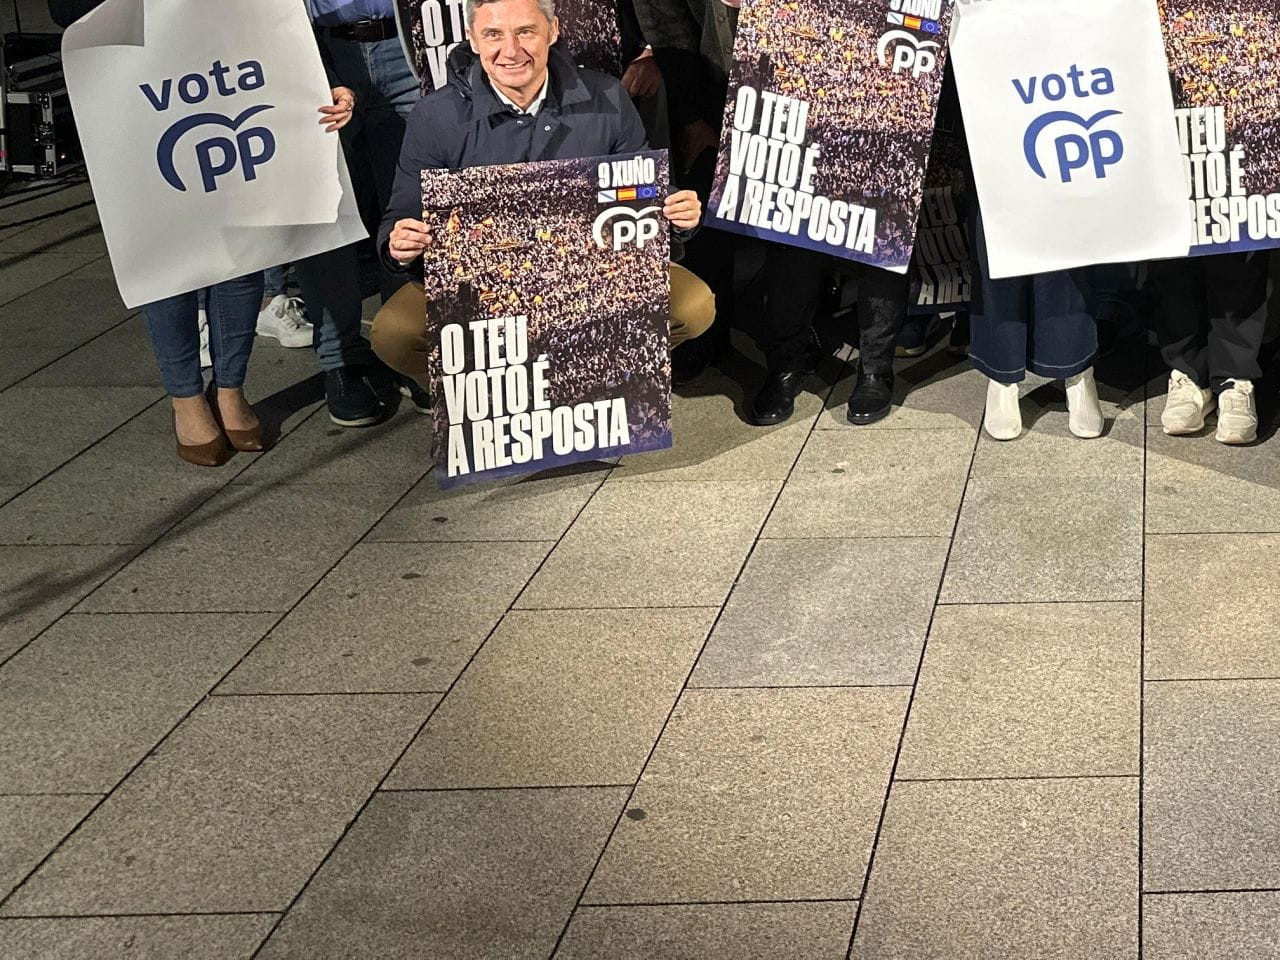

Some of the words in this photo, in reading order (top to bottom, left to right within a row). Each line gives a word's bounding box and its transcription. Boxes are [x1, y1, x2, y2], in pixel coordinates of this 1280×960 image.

[421, 0, 445, 47] O
[138, 59, 266, 112] vota
[1011, 63, 1116, 104] vota
[733, 85, 758, 132] O
[759, 91, 809, 145] TEU
[598, 162, 610, 187] 9
[612, 156, 655, 187] XUÑO
[729, 128, 801, 188] VOTO
[801, 143, 821, 193] É
[1181, 152, 1227, 199] TO
[1229, 144, 1247, 197] É
[716, 175, 742, 222] A
[739, 180, 877, 255] RESPOSTA
[440, 323, 465, 375] O
[469, 314, 529, 371] TEU
[443, 364, 530, 426] VOTO
[533, 354, 551, 411] É
[448, 424, 470, 477] A
[472, 397, 631, 472] RESPOSTA
